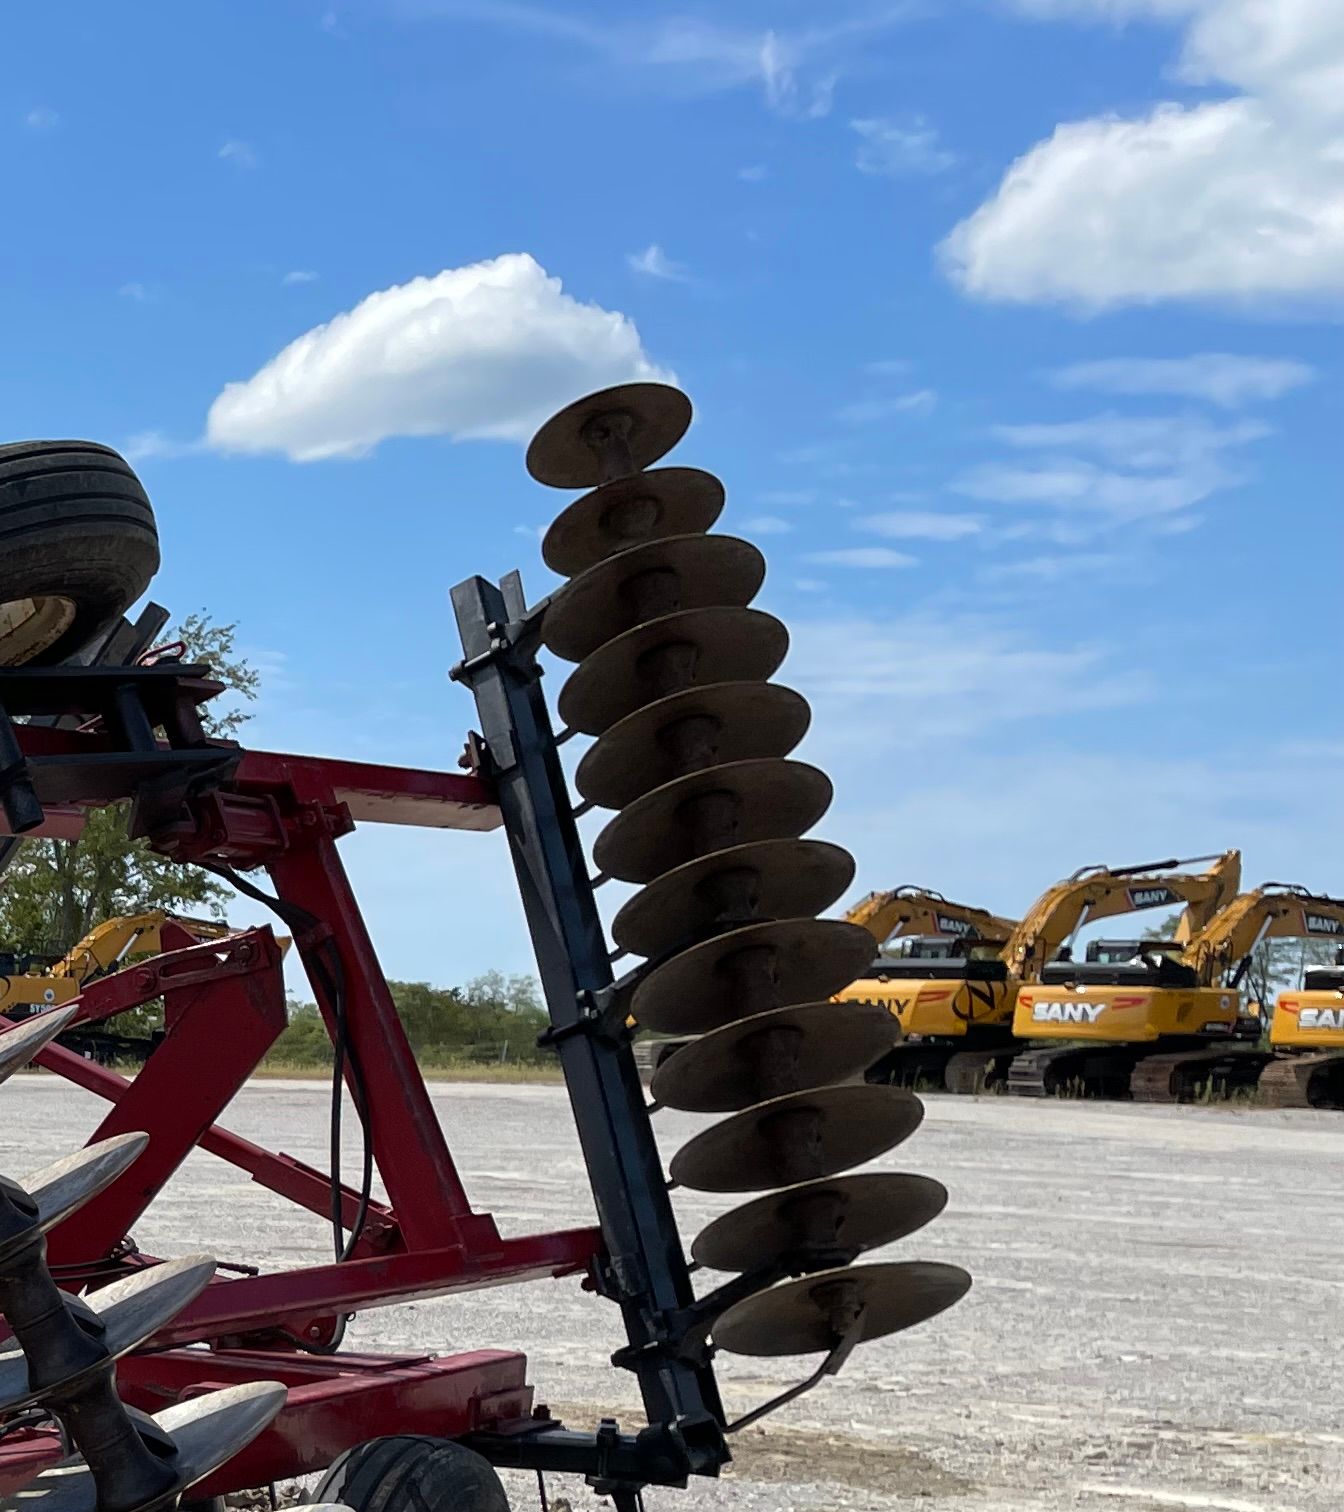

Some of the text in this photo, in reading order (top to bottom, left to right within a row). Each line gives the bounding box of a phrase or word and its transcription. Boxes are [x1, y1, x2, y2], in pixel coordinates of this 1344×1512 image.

[1134, 889, 1168, 905] SANY
[1308, 916, 1340, 932] SANY
[1032, 1001, 1106, 1023] SANY
